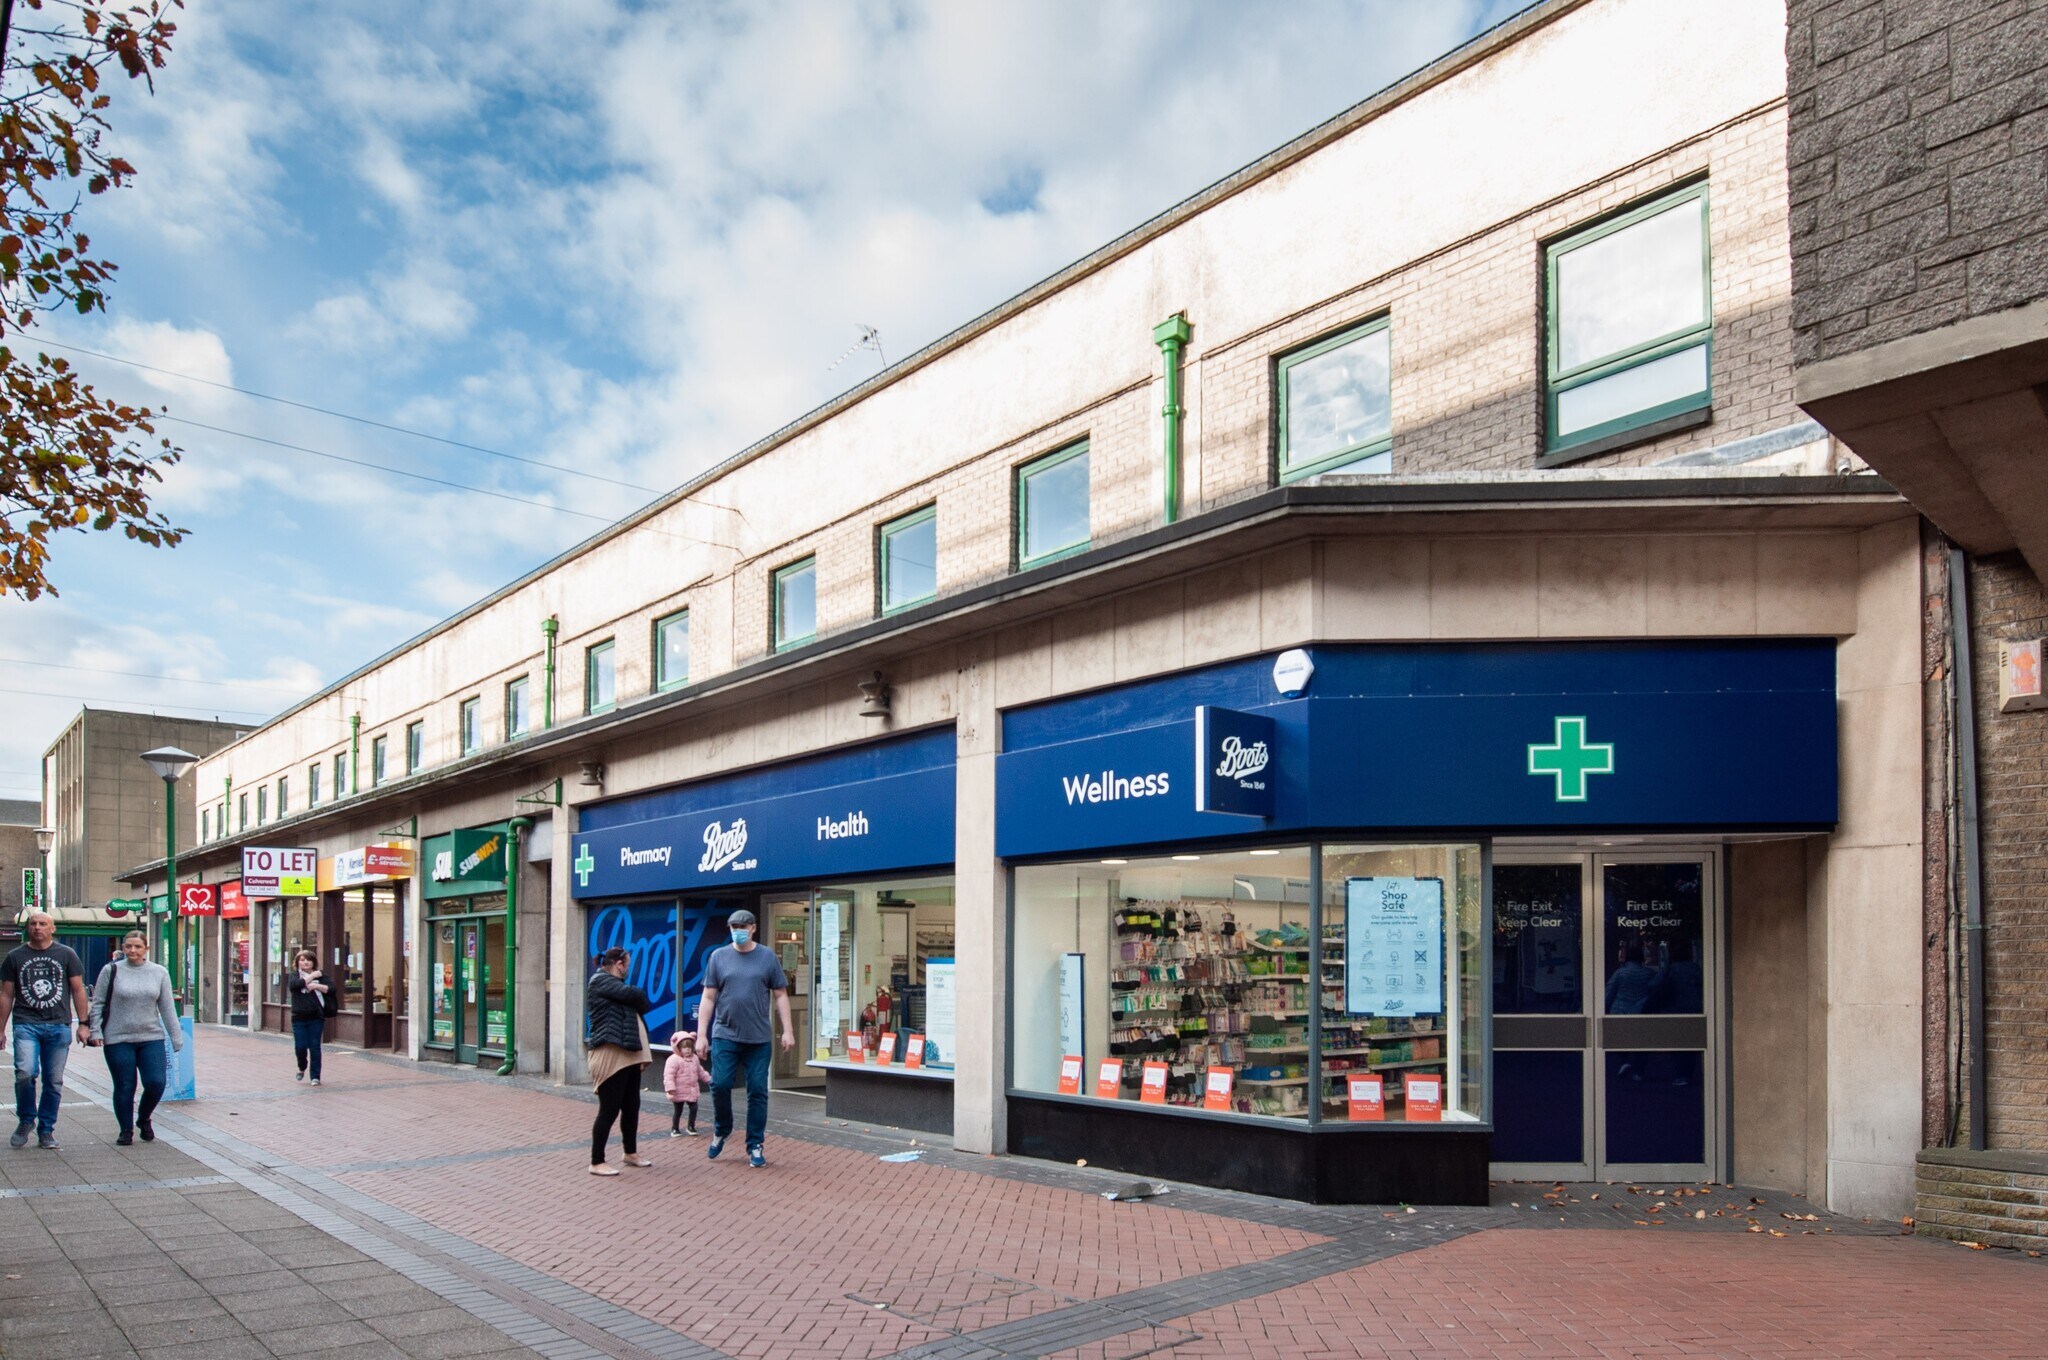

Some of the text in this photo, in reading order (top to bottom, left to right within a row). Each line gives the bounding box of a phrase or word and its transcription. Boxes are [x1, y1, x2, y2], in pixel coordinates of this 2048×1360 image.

[1215, 735, 1269, 780] Boots
[1062, 769, 1170, 806] Wellness
[1240, 779, 1265, 790] Since 1849
[817, 810, 869, 841] Health
[459, 834, 499, 876] SUBWAY
[698, 817, 748, 873] Boots
[245, 851, 315, 872] TO LET
[620, 846, 672, 867] Pharmacy
[25, 870, 34, 904] Buffet
[1381, 890, 1408, 902] Shop
[1381, 900, 1405, 910] Safe
[1507, 900, 1553, 911] Fire Exit
[1626, 900, 1673, 911] Fire Exit
[1499, 916, 1562, 929] Keep Clear
[1617, 916, 1682, 929] Keep Clear
